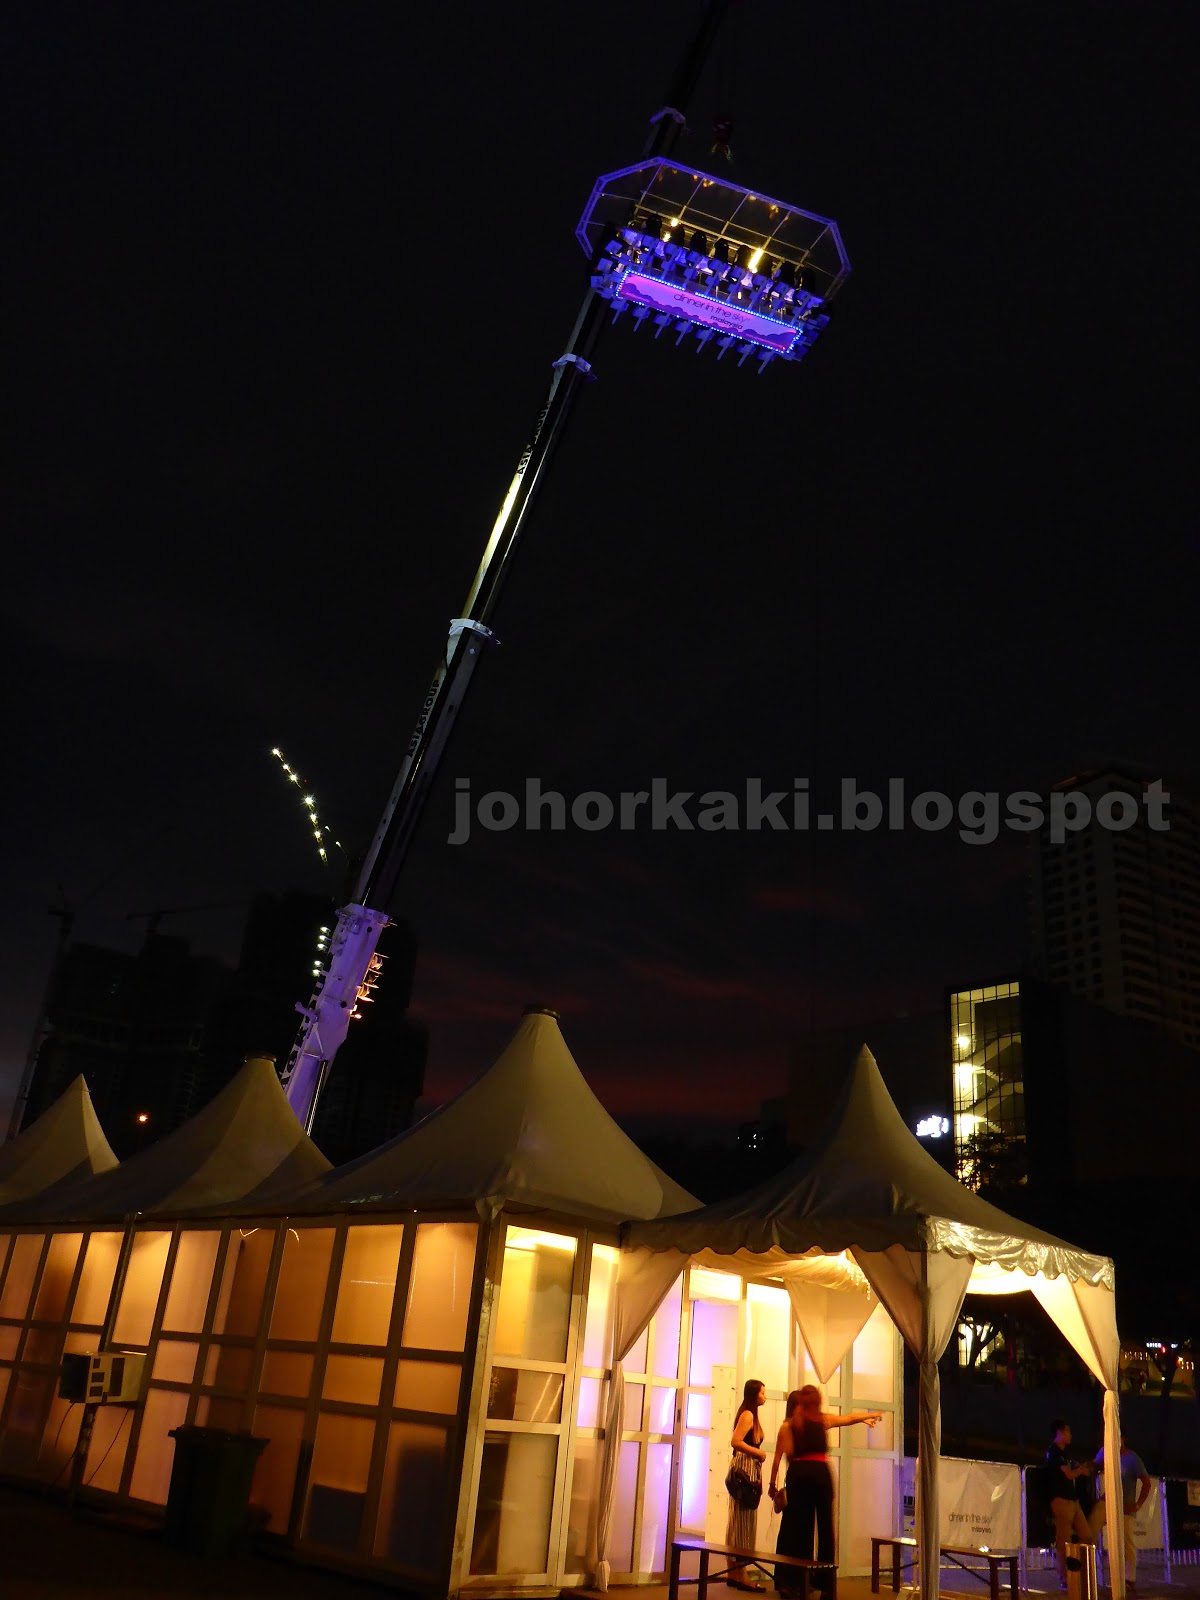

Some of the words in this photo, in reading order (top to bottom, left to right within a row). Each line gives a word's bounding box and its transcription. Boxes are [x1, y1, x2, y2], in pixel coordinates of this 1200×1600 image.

[674, 293, 705, 309] dinner
[705, 303, 714, 312] in
[715, 307, 732, 318] the
[710, 315, 744, 330] malaysia
